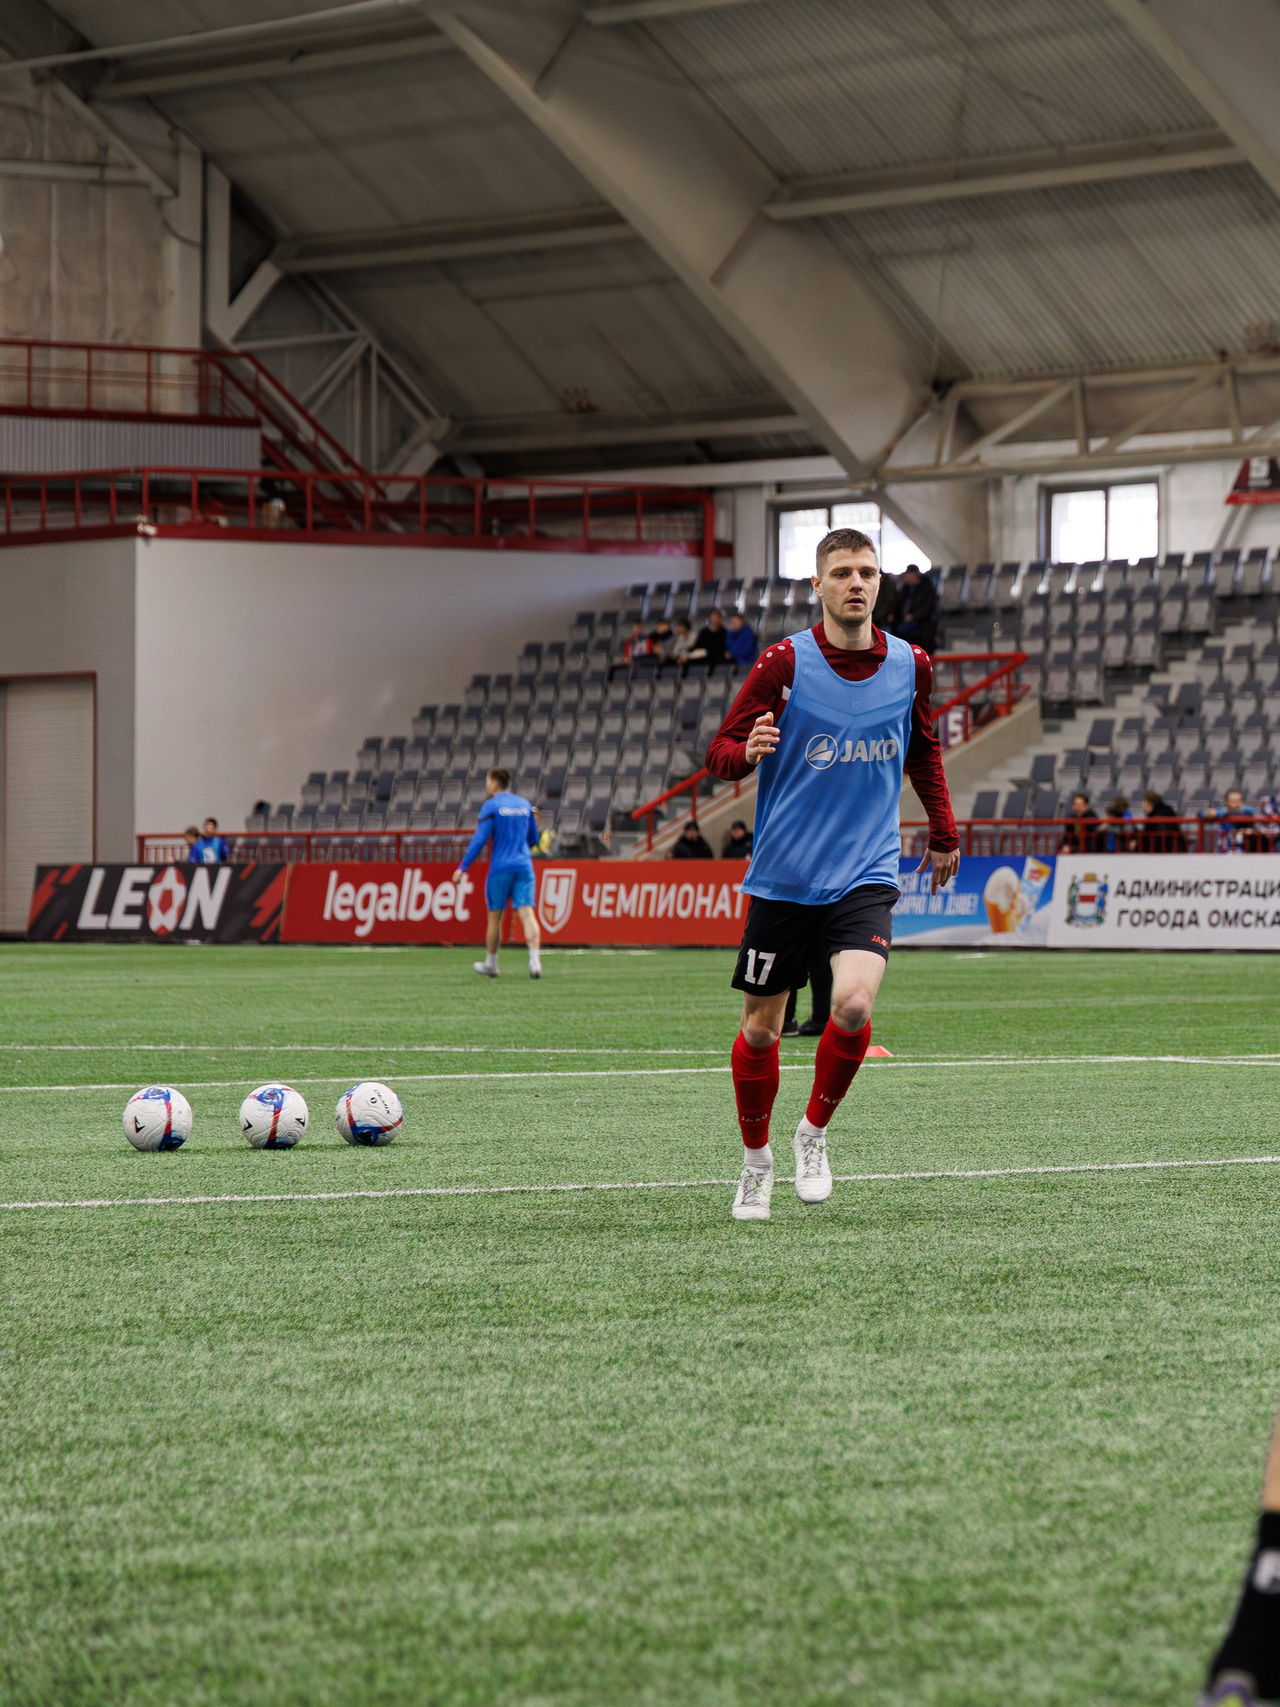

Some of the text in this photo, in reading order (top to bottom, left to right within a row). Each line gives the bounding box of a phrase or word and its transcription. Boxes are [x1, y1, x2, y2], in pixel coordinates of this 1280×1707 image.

[840, 738, 898, 763] JAKO
[77, 866, 233, 936] LEON
[323, 868, 474, 937] legalbet
[582, 883, 744, 919] ЧЕМПИОНАТ
[1117, 909, 1200, 930] ГОРОДА
[744, 948, 777, 986] 17
[373, 1089, 392, 1115] DEMIX
